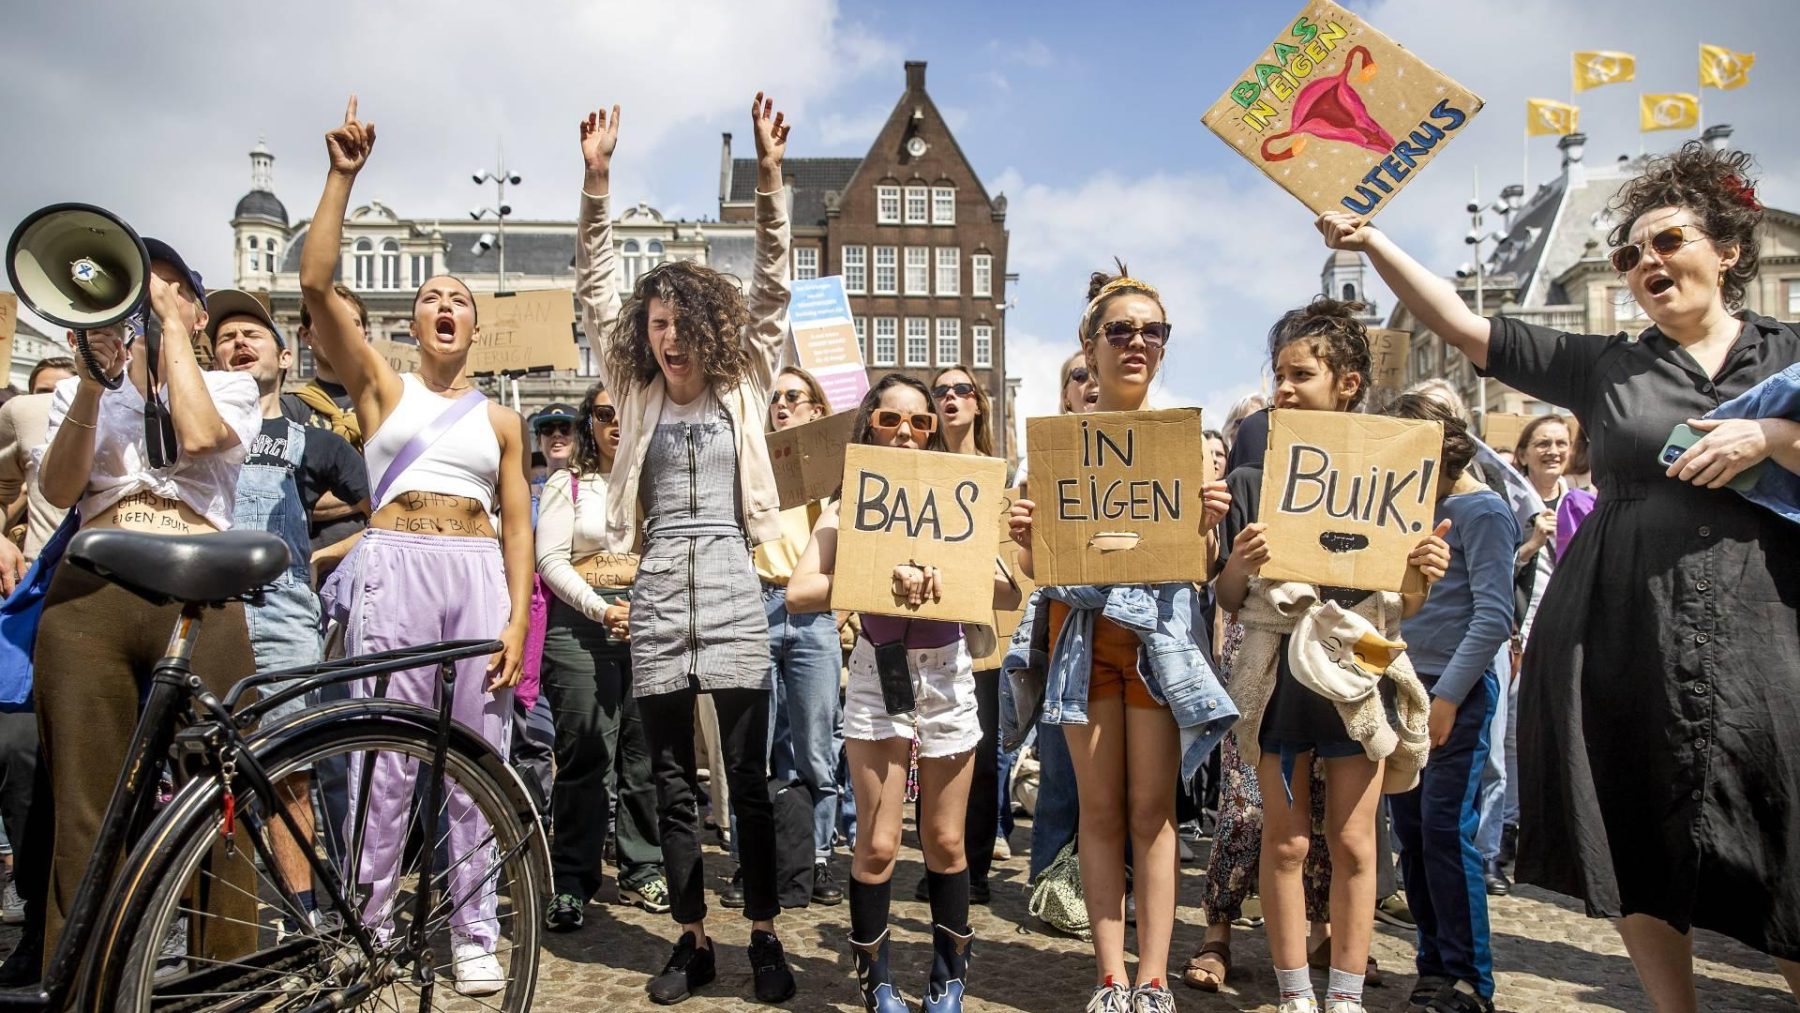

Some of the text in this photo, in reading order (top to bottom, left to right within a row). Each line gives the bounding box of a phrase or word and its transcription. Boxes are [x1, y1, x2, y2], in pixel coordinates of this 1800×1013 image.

[1230, 16, 1318, 109] BAAS
[1242, 20, 1348, 133] IN EIGEN
[1340, 98, 1467, 216] UTERUS
[112, 512, 190, 534] EIGEN BUIK
[394, 516, 488, 537] EIGEN BUIK
[854, 469, 980, 542] BAAS
[585, 572, 624, 586] EIGEN
